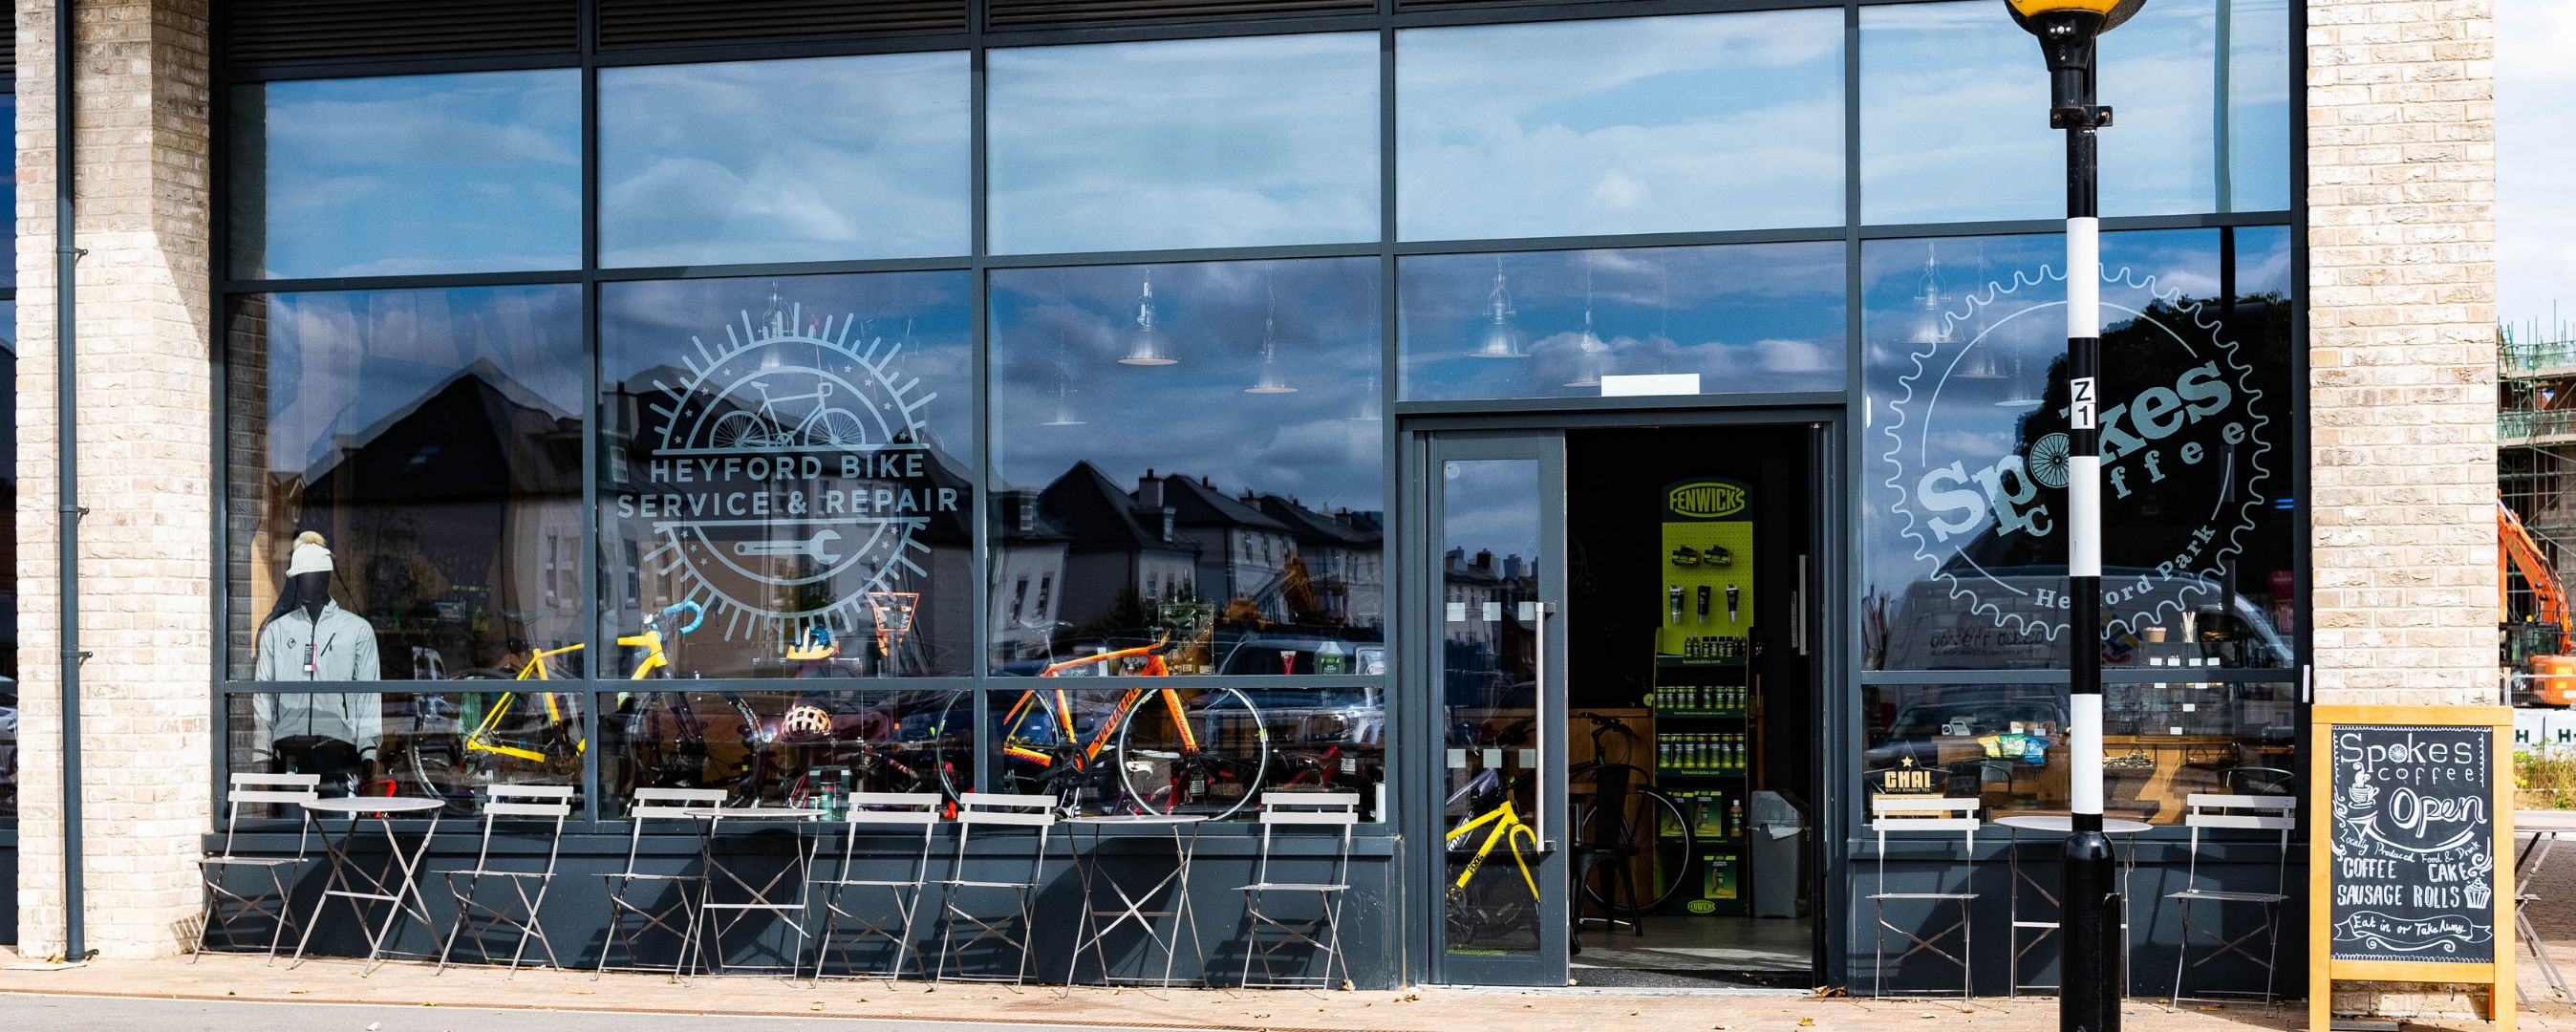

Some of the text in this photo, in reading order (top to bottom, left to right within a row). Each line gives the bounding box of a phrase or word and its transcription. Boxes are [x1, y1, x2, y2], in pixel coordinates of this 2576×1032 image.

[2073, 381, 2092, 402] Z
[2077, 407, 2090, 426] 1
[651, 454, 924, 483] HEYFORD BIKE
[2025, 421, 2245, 537] Cffee
[617, 488, 957, 518] SERVICE & REPAIR
[2034, 525, 2215, 609] Heord Park
[2340, 733, 2473, 773] Spokes
[1885, 771, 1930, 787] CHAI
[2377, 767, 2475, 785] coffee
[2389, 787, 2487, 838] Open
[2339, 828, 2481, 864] Locally Produced Food & Drink
[2343, 857, 2469, 883] COFFEE CAKE
[2337, 884, 2460, 909] SAUSAGE ROLLS
[2352, 915, 2467, 936] Eat in or Take Away
